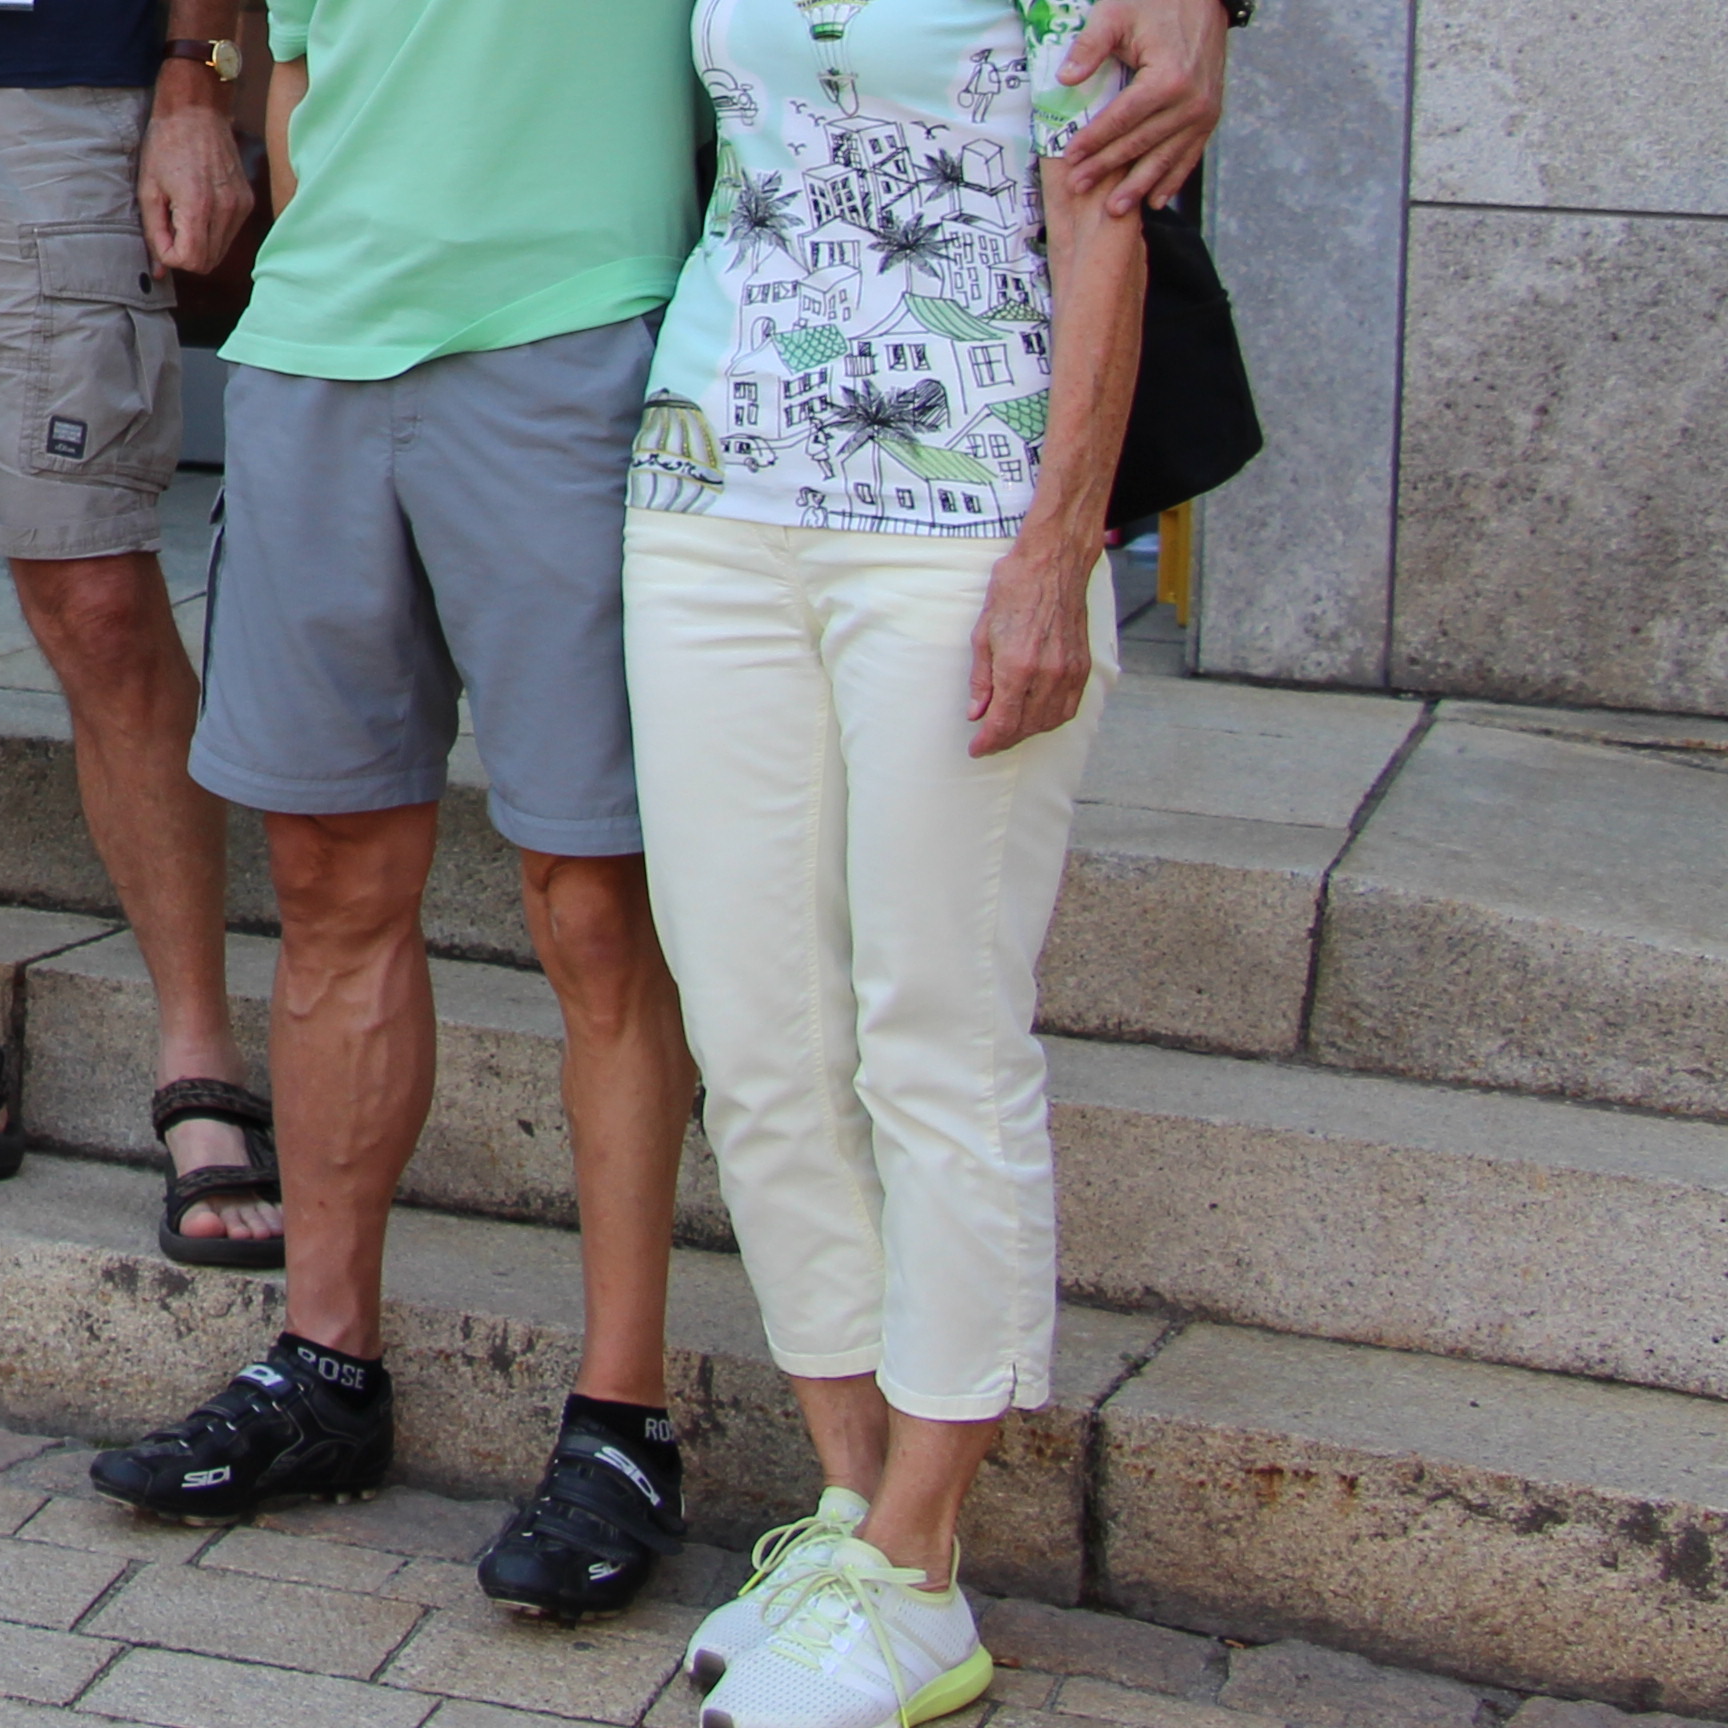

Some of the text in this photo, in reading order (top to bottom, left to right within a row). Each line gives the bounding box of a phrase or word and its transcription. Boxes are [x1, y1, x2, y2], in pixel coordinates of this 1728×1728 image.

[645, 1417, 676, 1442] RO
[181, 1465, 232, 1489] SIDI
[594, 1445, 662, 1506] SIDI
